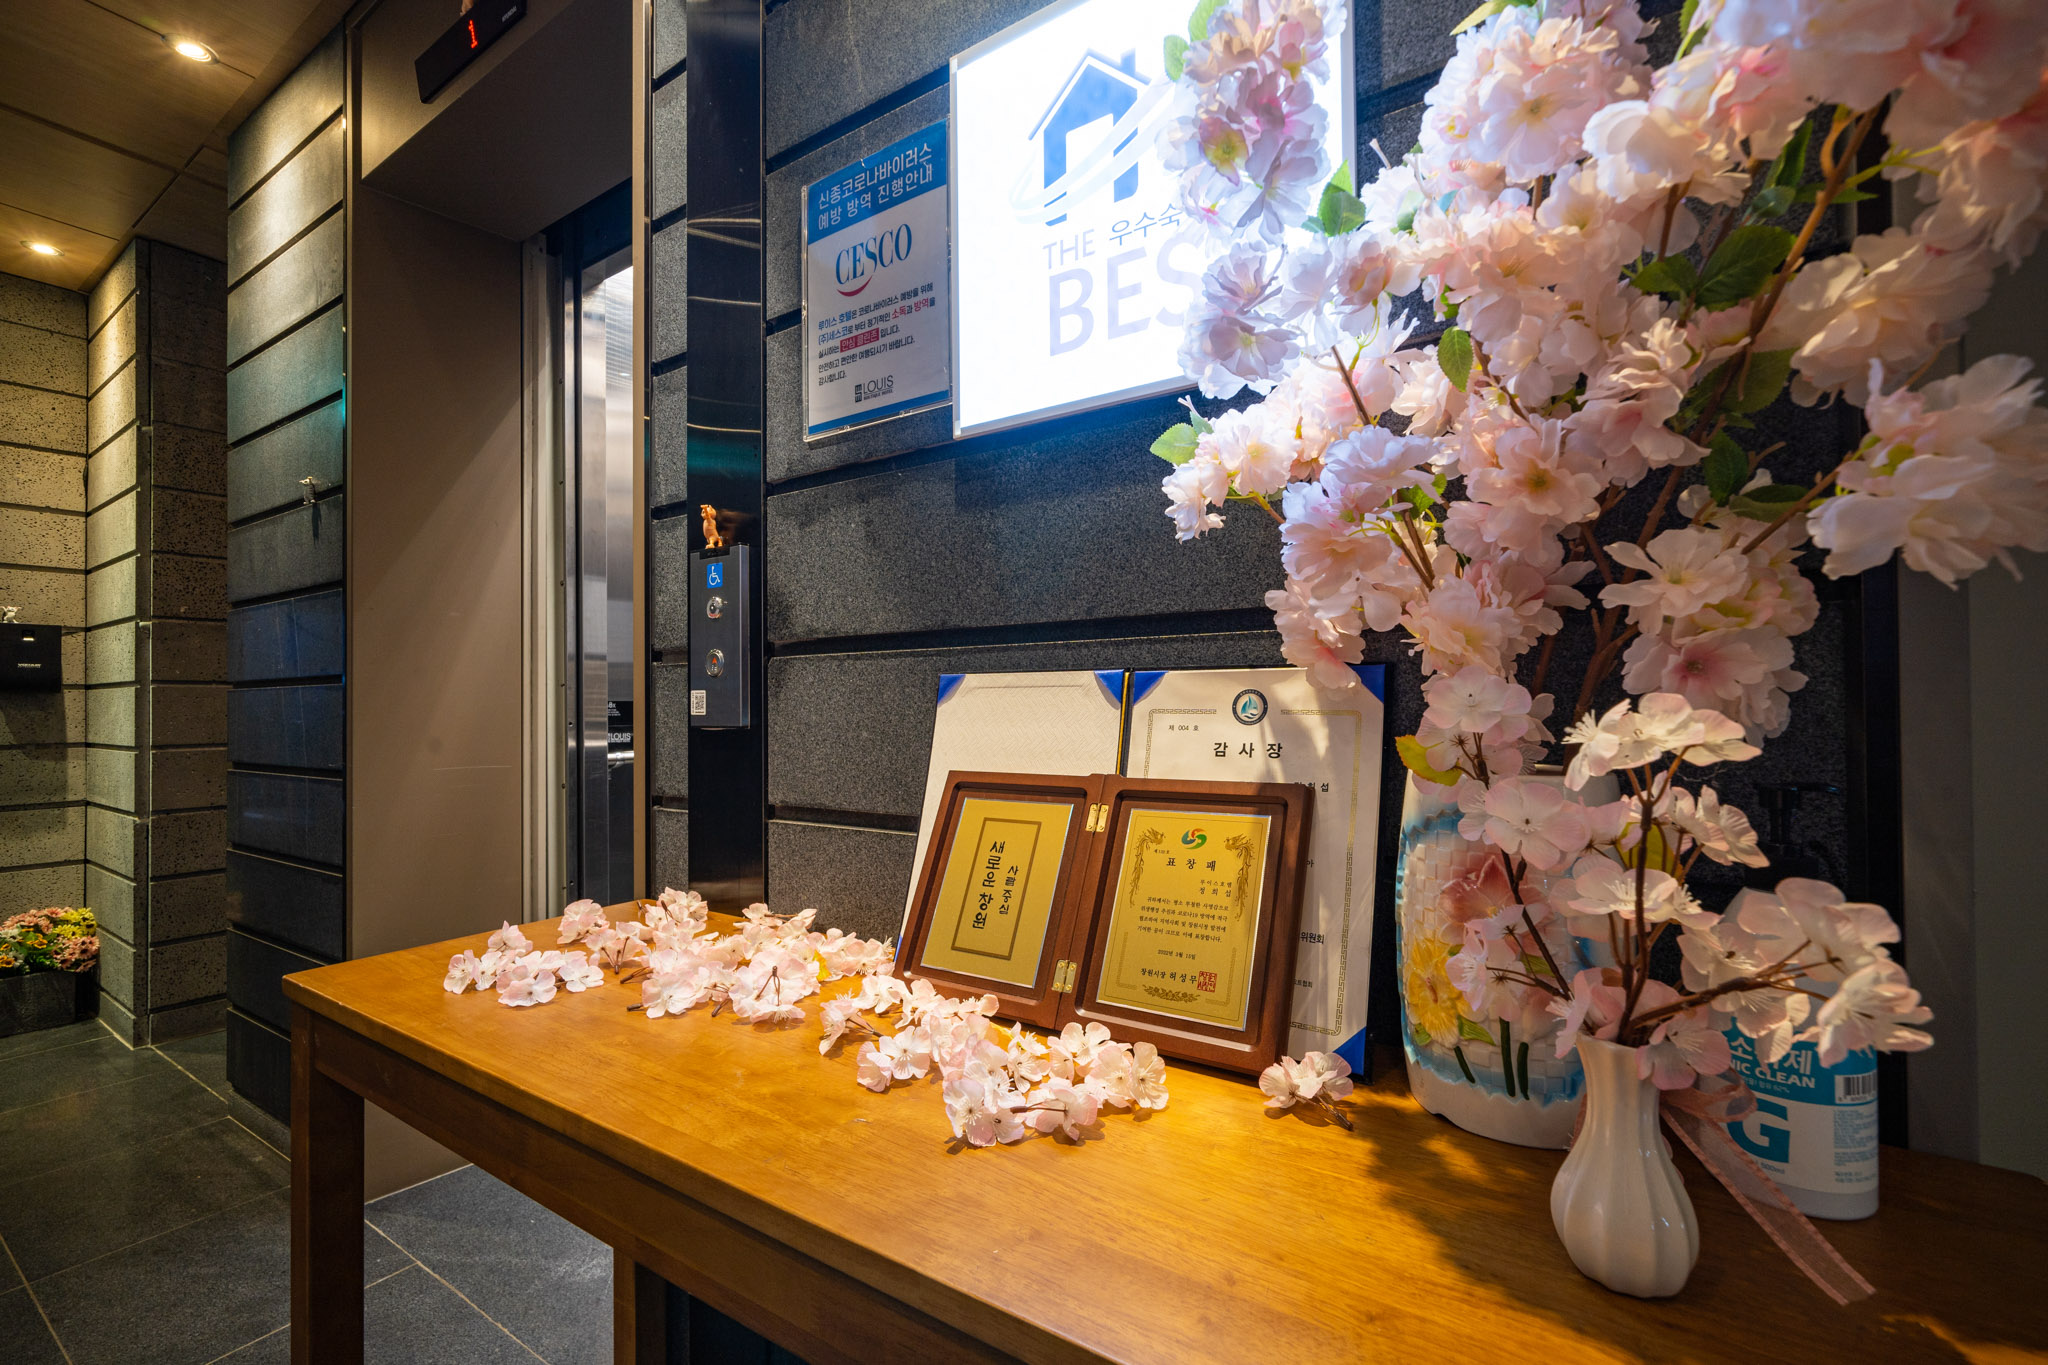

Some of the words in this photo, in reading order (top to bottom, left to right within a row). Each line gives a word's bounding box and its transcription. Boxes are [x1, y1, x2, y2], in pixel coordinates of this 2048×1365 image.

[818, 142, 932, 210] 신종코로나바이러스
[818, 206, 842, 230] 예방
[847, 192, 872, 218] 방역
[835, 223, 912, 285] CESCO
[1042, 228, 1096, 270] THE
[818, 317, 837, 331] 루이스
[839, 309, 857, 324] 호텔은
[858, 295, 899, 317] 코로나바이러스
[900, 287, 919, 302] 예방을
[920, 282, 933, 294] 위해
[855, 320, 866, 332] 부터
[867, 312, 890, 327] 정기적인
[892, 305, 913, 319] 소독과
[914, 297, 935, 312] 방역을
[818, 359, 840, 373] 안전하고
[840, 353, 857, 366] 편안한
[858, 344, 888, 360] 여행되시기
[888, 335, 915, 348] 바랍니다.
[841, 339, 855, 351] 안심
[857, 329, 878, 346] 클린존
[880, 324, 900, 338] 입니다.
[863, 374, 894, 394] LOUIS
[1168, 724, 1175, 732] 제
[1193, 724, 1199, 732] 호
[982, 840, 1006, 888] 새로운
[972, 892, 994, 930] 창원
[1300, 931, 1325, 944] 위원회
[1141, 967, 1166, 979] 창원시장
[1729, 1037, 1812, 1075] 소제
[1755, 1067, 1816, 1089] CLEAN
